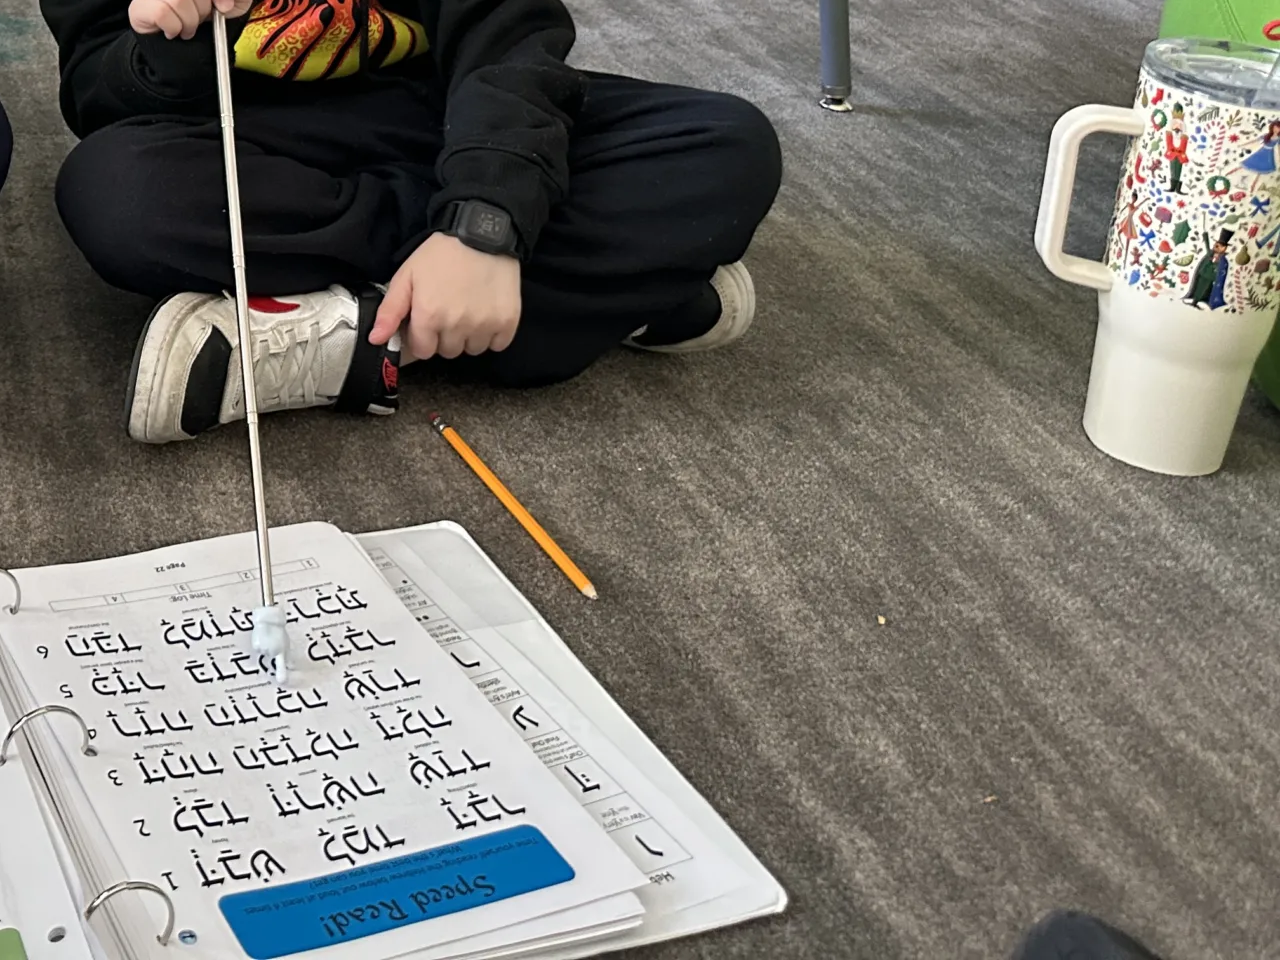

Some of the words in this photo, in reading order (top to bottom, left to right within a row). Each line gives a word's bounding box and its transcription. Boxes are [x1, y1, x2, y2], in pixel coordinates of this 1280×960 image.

[155, 565, 166, 573] 22
[167, 561, 186, 571] Page
[169, 593, 188, 604] Log:
[190, 590, 212, 600] Time
[36, 646, 48, 659] 6
[60, 685, 73, 699] 5
[108, 770, 122, 786] 3
[133, 819, 151, 837] 2
[161, 871, 179, 890] 1
[409, 874, 495, 914] Speed
[318, 899, 408, 938] Read!
